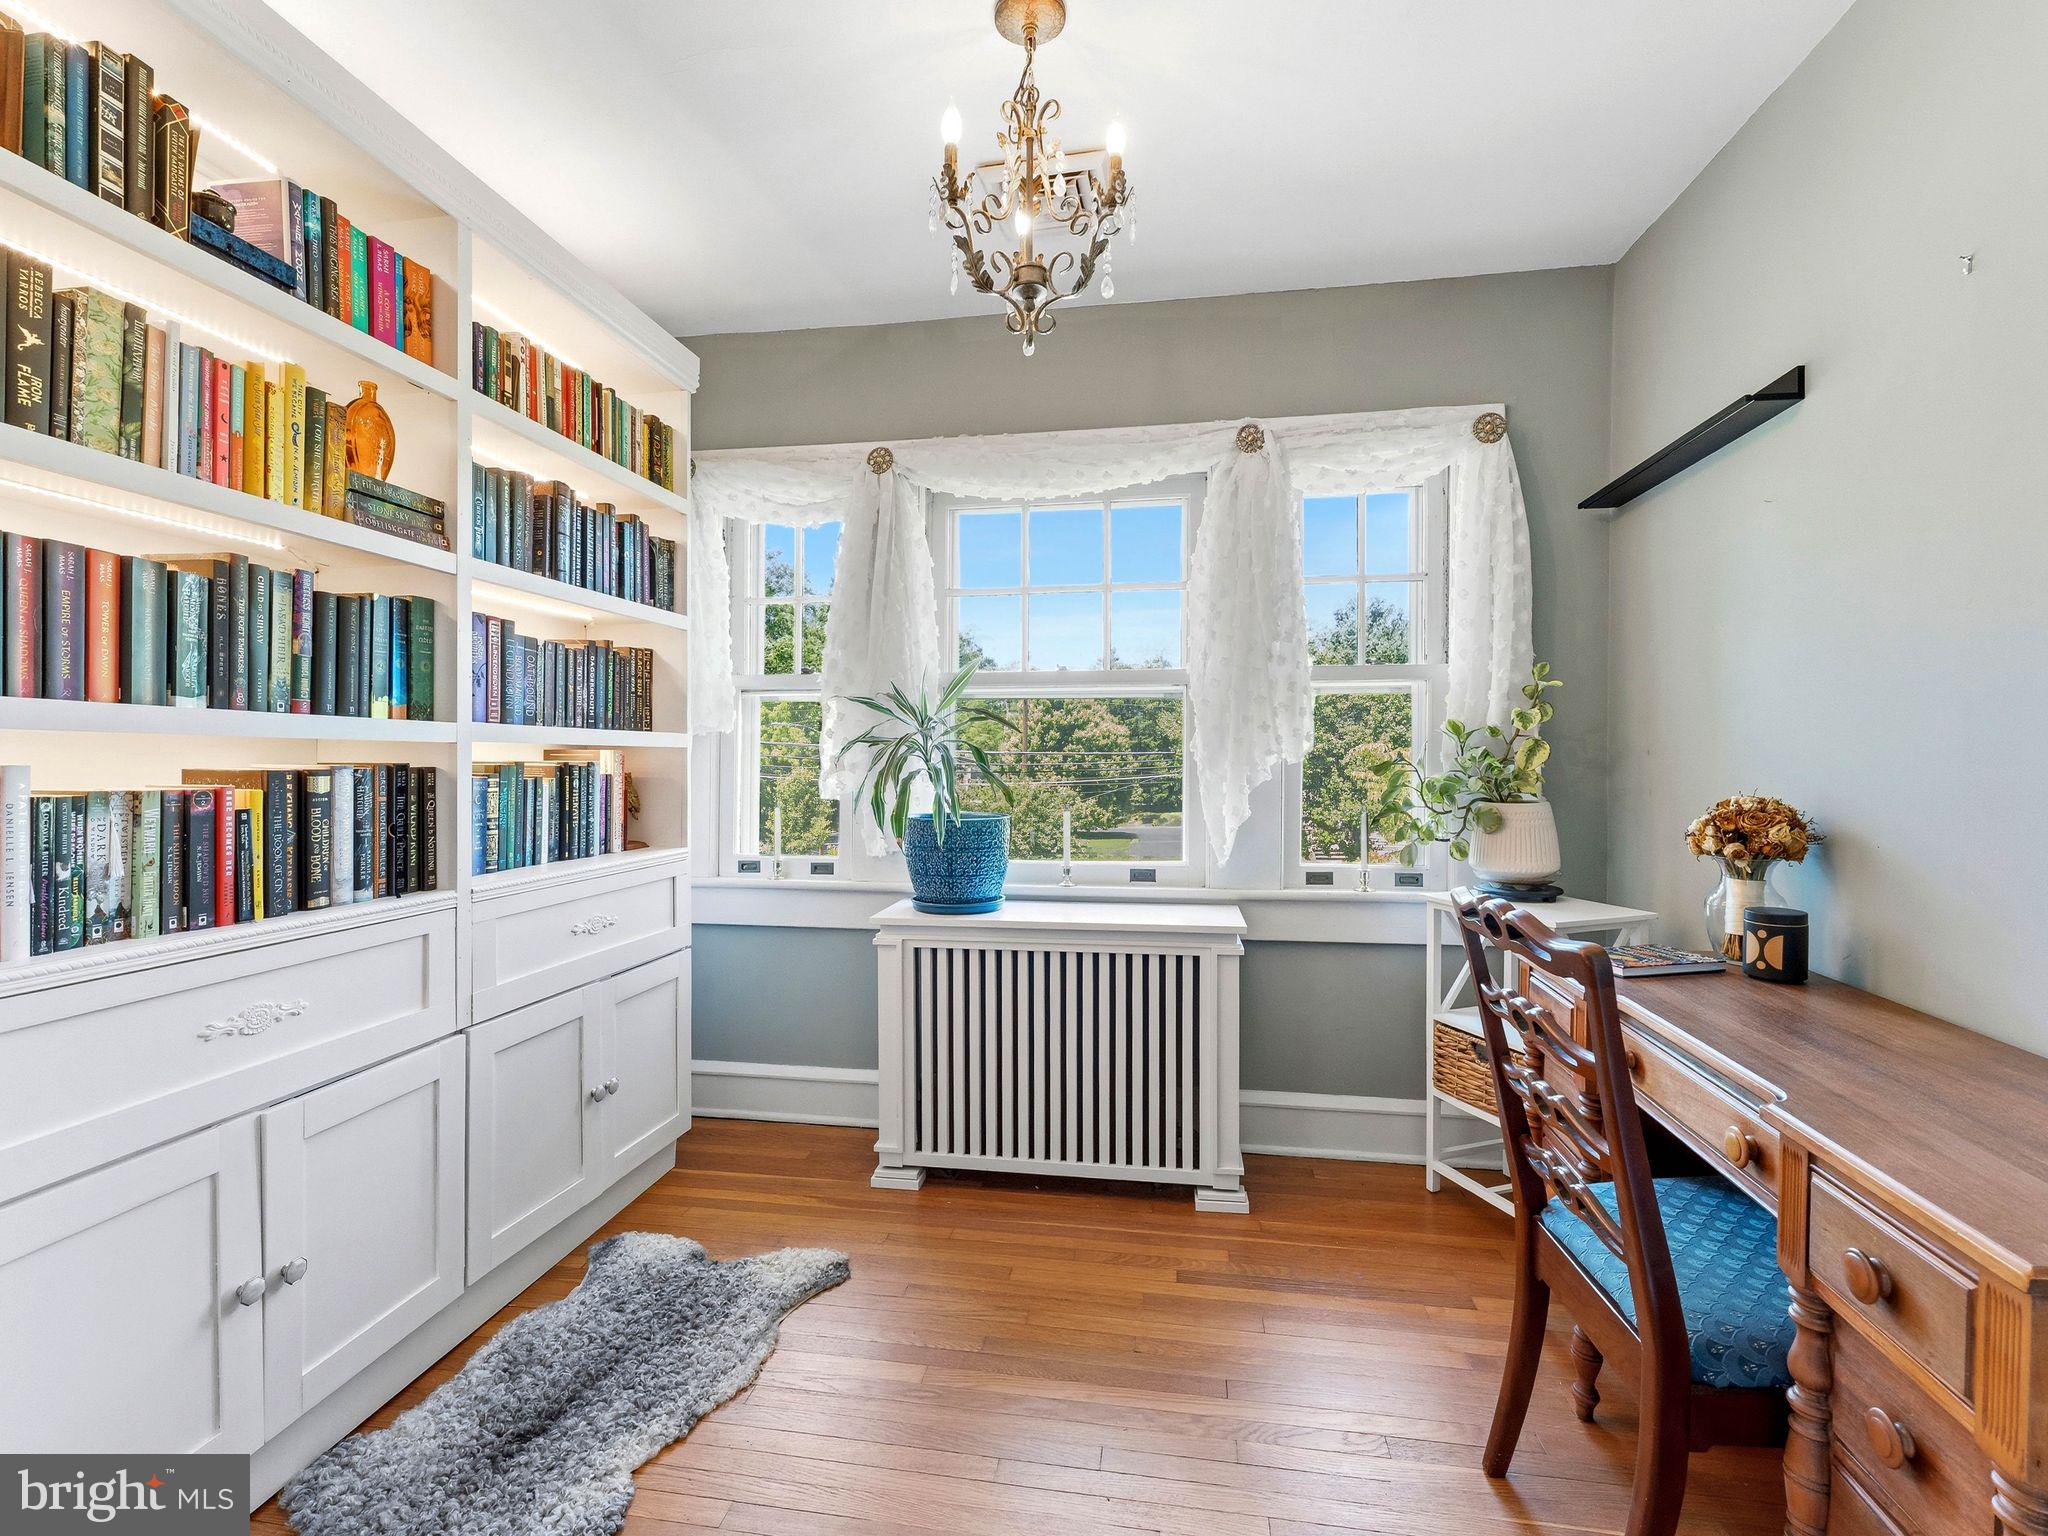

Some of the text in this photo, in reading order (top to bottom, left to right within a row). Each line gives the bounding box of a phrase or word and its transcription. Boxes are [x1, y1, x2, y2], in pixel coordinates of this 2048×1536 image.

[18, 267, 28, 310] YARROS
[33, 269, 44, 319] REBECCA
[17, 363, 32, 407] FLAME
[31, 375, 42, 403] IRON
[24, 543, 32, 566] SARAH
[61, 589, 71, 624] EMPIRE
[257, 576, 265, 603] CHILD
[19, 577, 29, 680] QUEEN SHADOWS
[101, 599, 109, 679] TOWER DAWN
[61, 640, 71, 680] STORMS
[505, 639, 514, 709] LEGENDBORN
[526, 655, 535, 717] OATHBOUND
[5, 803, 15, 853] DANIELLE
[19, 794, 27, 825] FATE
[41, 813, 50, 842] OCTAVIA
[274, 815, 283, 832] THE
[311, 807, 321, 842] BLOOD
[379, 802, 387, 846] MADELINE
[96, 823, 105, 862] DARK
[121, 816, 130, 864] TWISTED
[225, 816, 233, 856] BECOMES
[274, 833, 283, 862] BOOK
[322, 818, 330, 864] CHILDREN
[426, 799, 436, 871] QUEEN NOTHING
[41, 850, 49, 877] BUTLER
[274, 864, 283, 877] OF
[310, 855, 321, 883] BONE
[5, 871, 15, 908] JENSEN
[58, 886, 70, 931] Kindred
